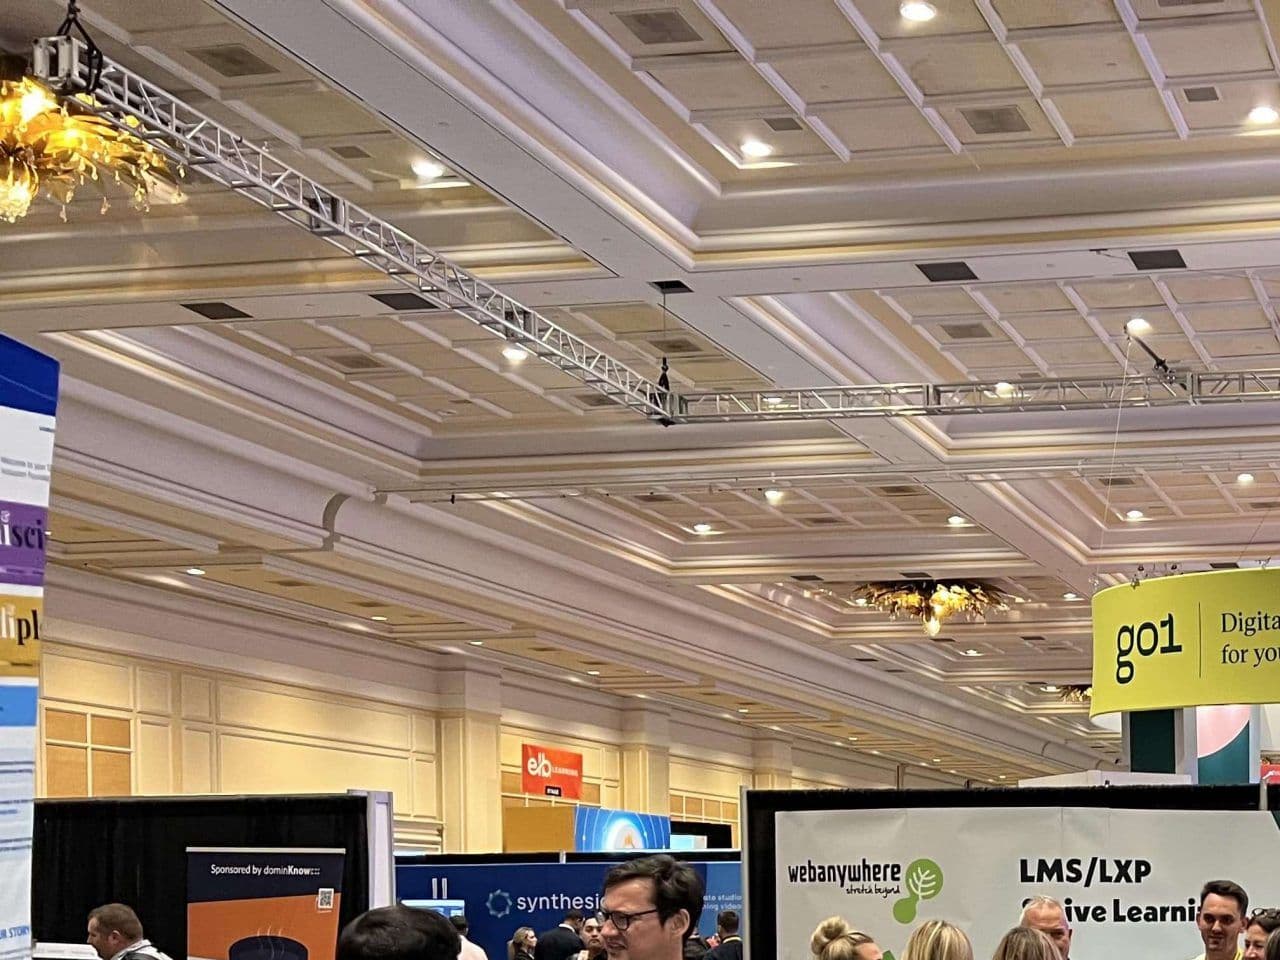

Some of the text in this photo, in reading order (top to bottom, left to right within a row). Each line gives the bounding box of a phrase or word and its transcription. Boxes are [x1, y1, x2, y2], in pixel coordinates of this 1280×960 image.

[1116, 613, 1183, 685] go1
[1221, 643, 1249, 664] for
[527, 752, 551, 778] elb
[211, 864, 311, 876] Sponsored by dominKnow
[788, 858, 901, 888] webanywhere
[1020, 857, 1152, 888] LMS/LXP
[1112, 898, 1200, 923] Learni
